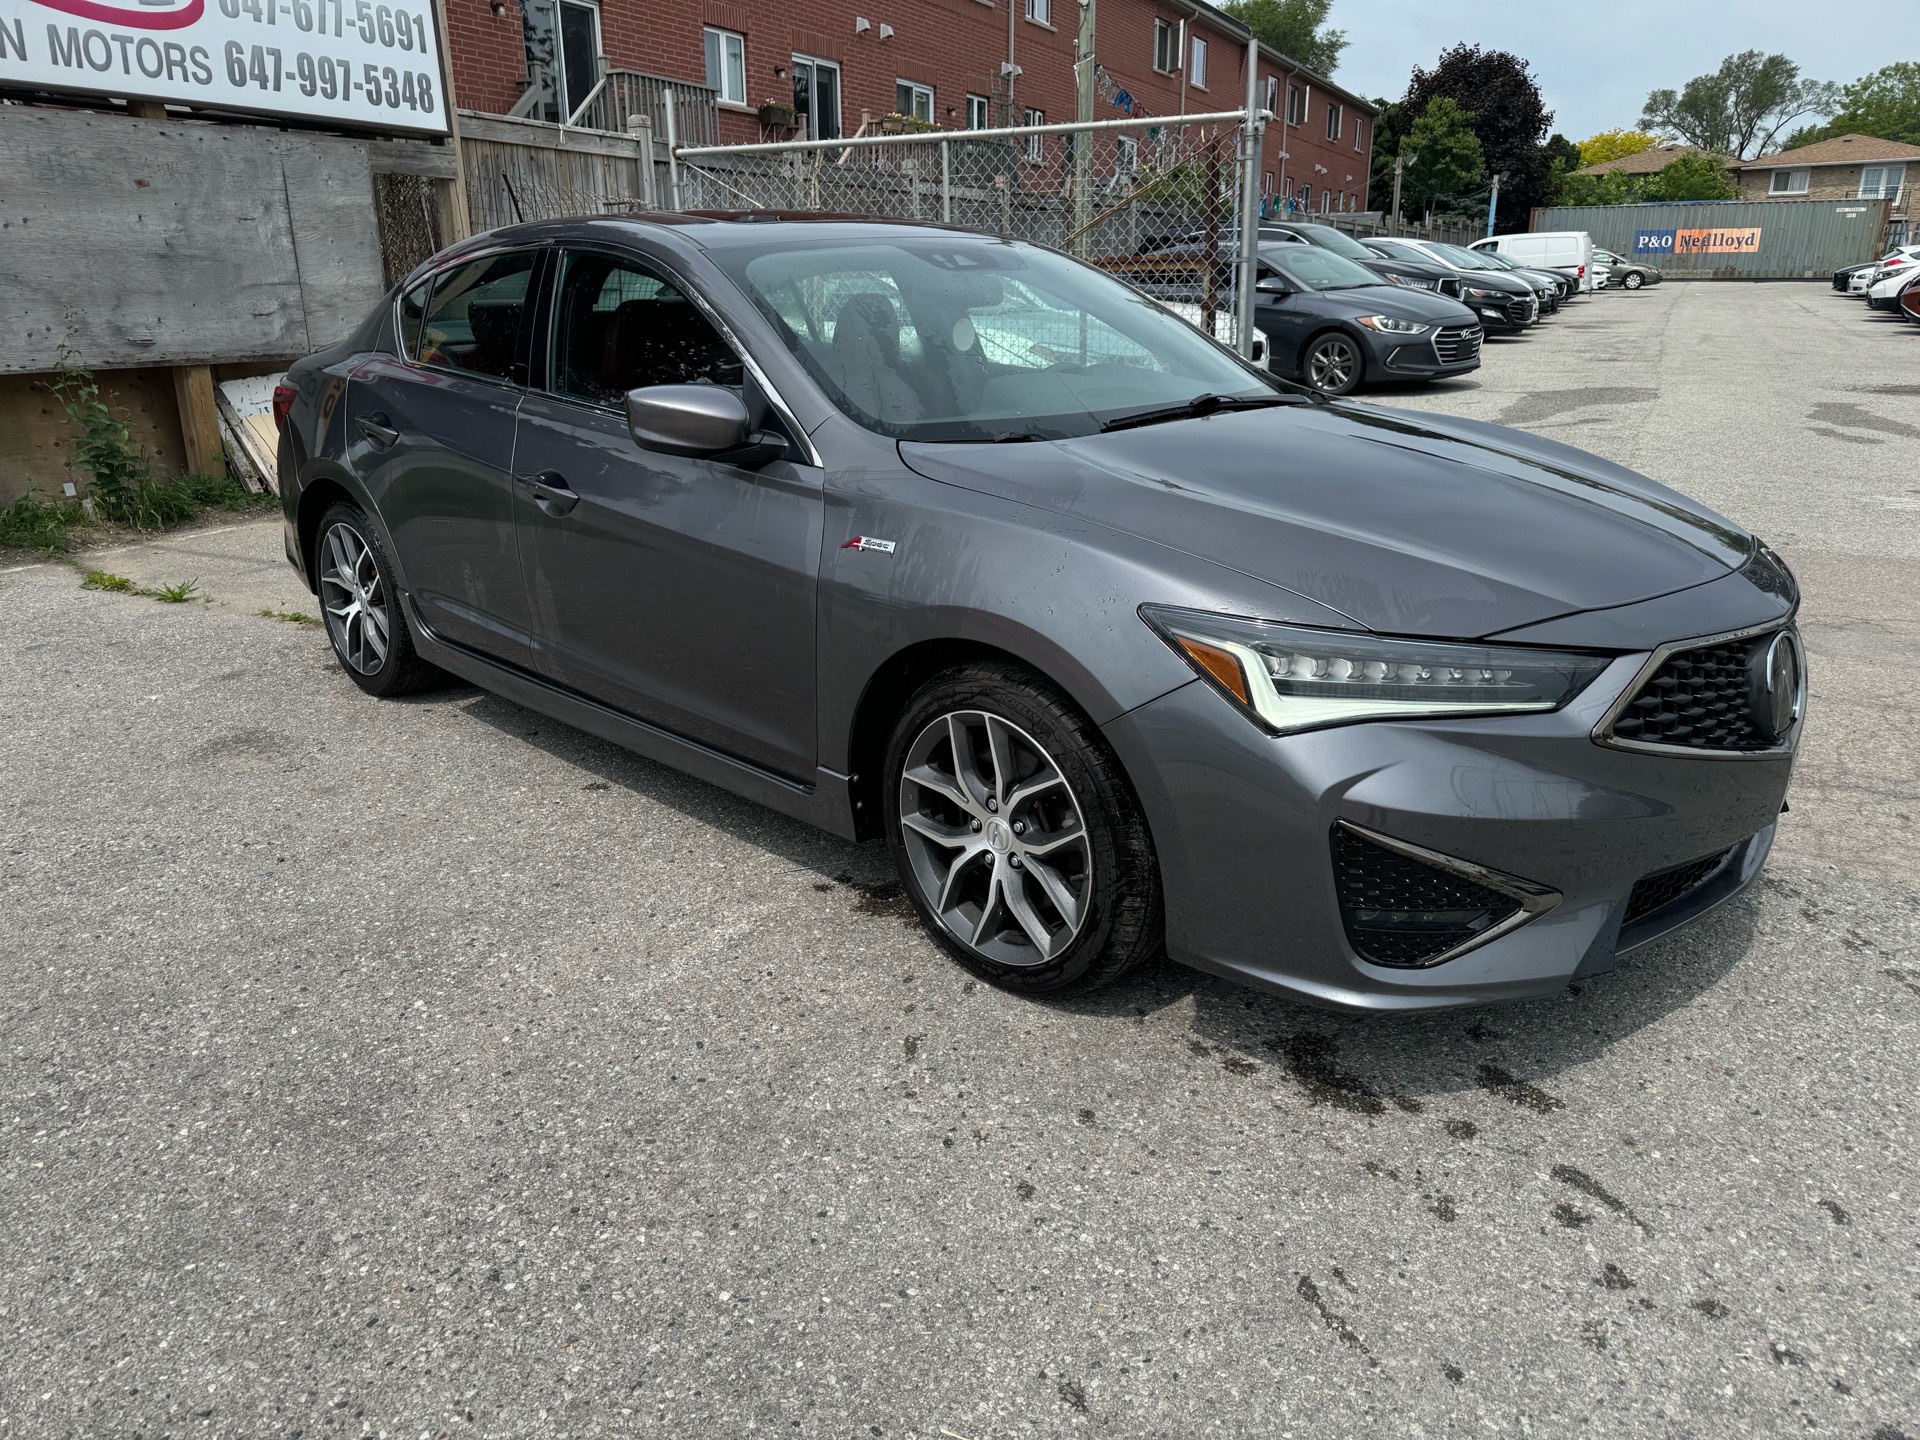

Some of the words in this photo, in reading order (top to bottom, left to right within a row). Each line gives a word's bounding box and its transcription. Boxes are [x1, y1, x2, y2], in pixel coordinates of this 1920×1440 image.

[47, 24, 213, 85] MOTORS
[224, 40, 435, 113] 647-997-5348
[1638, 235, 1672, 248] P&O
[1680, 232, 1755, 250] Nedlloyd
